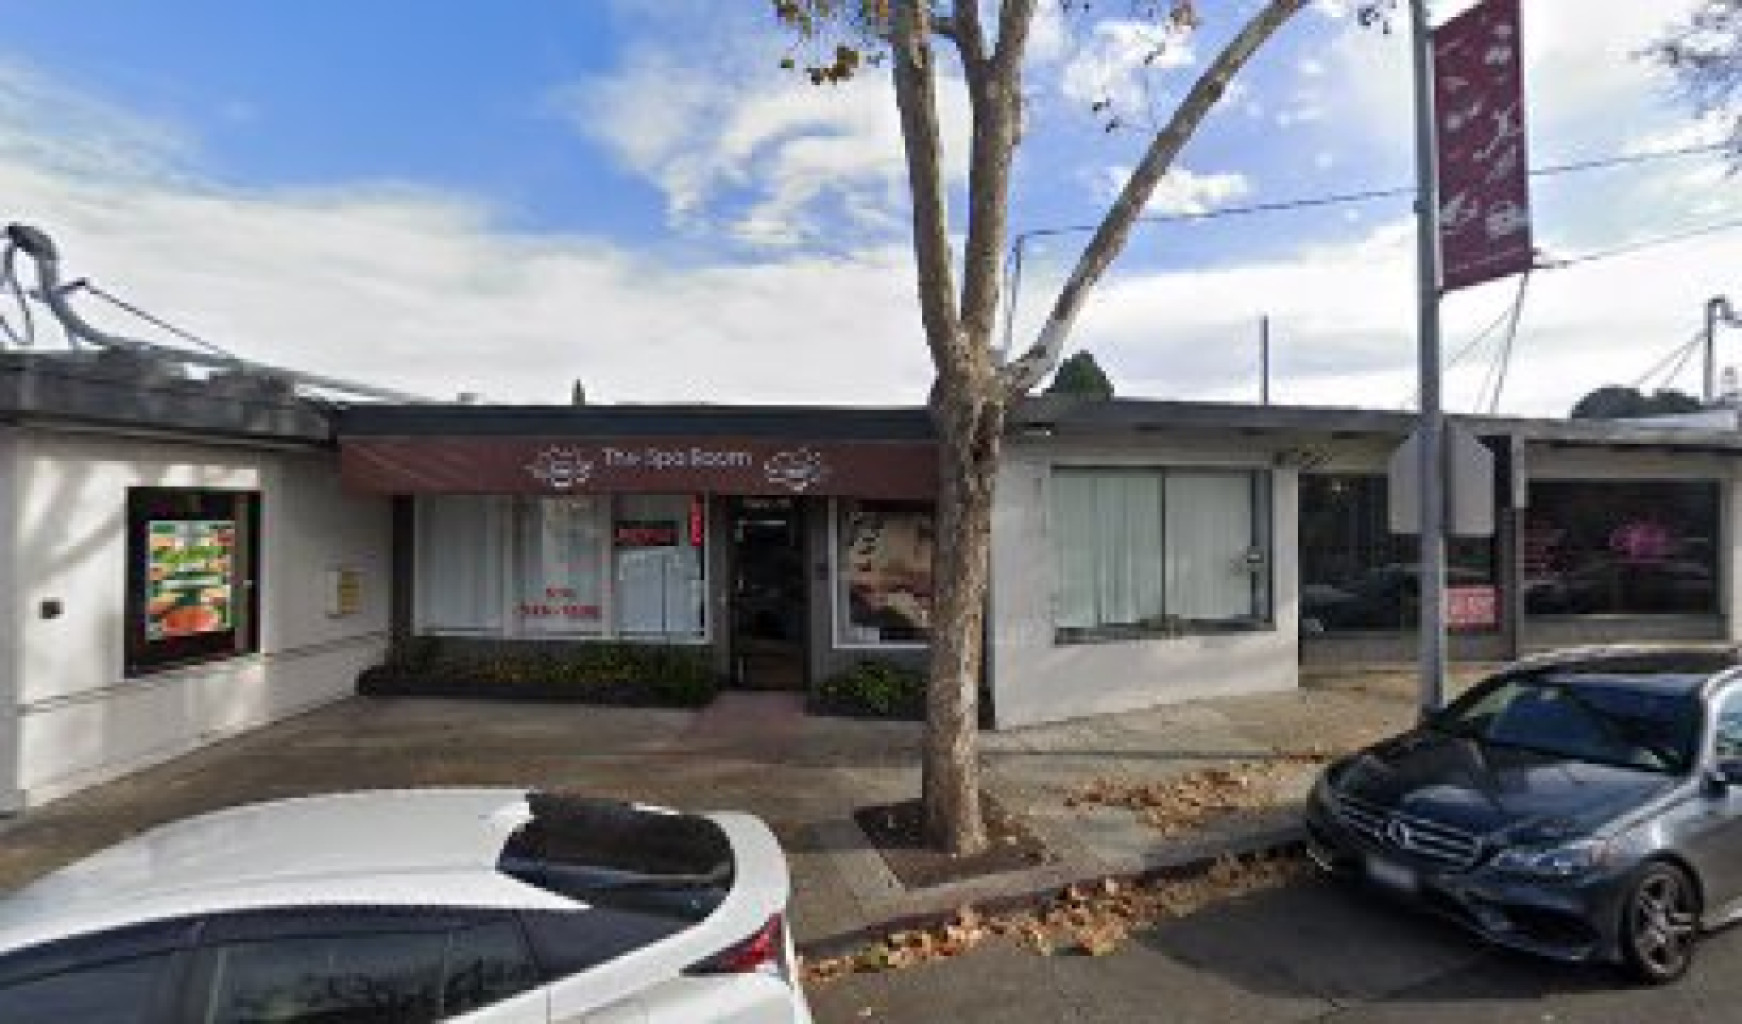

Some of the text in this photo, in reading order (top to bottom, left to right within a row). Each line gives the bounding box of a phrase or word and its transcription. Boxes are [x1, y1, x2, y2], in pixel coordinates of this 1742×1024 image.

[602, 446, 753, 471] The Spa Room
